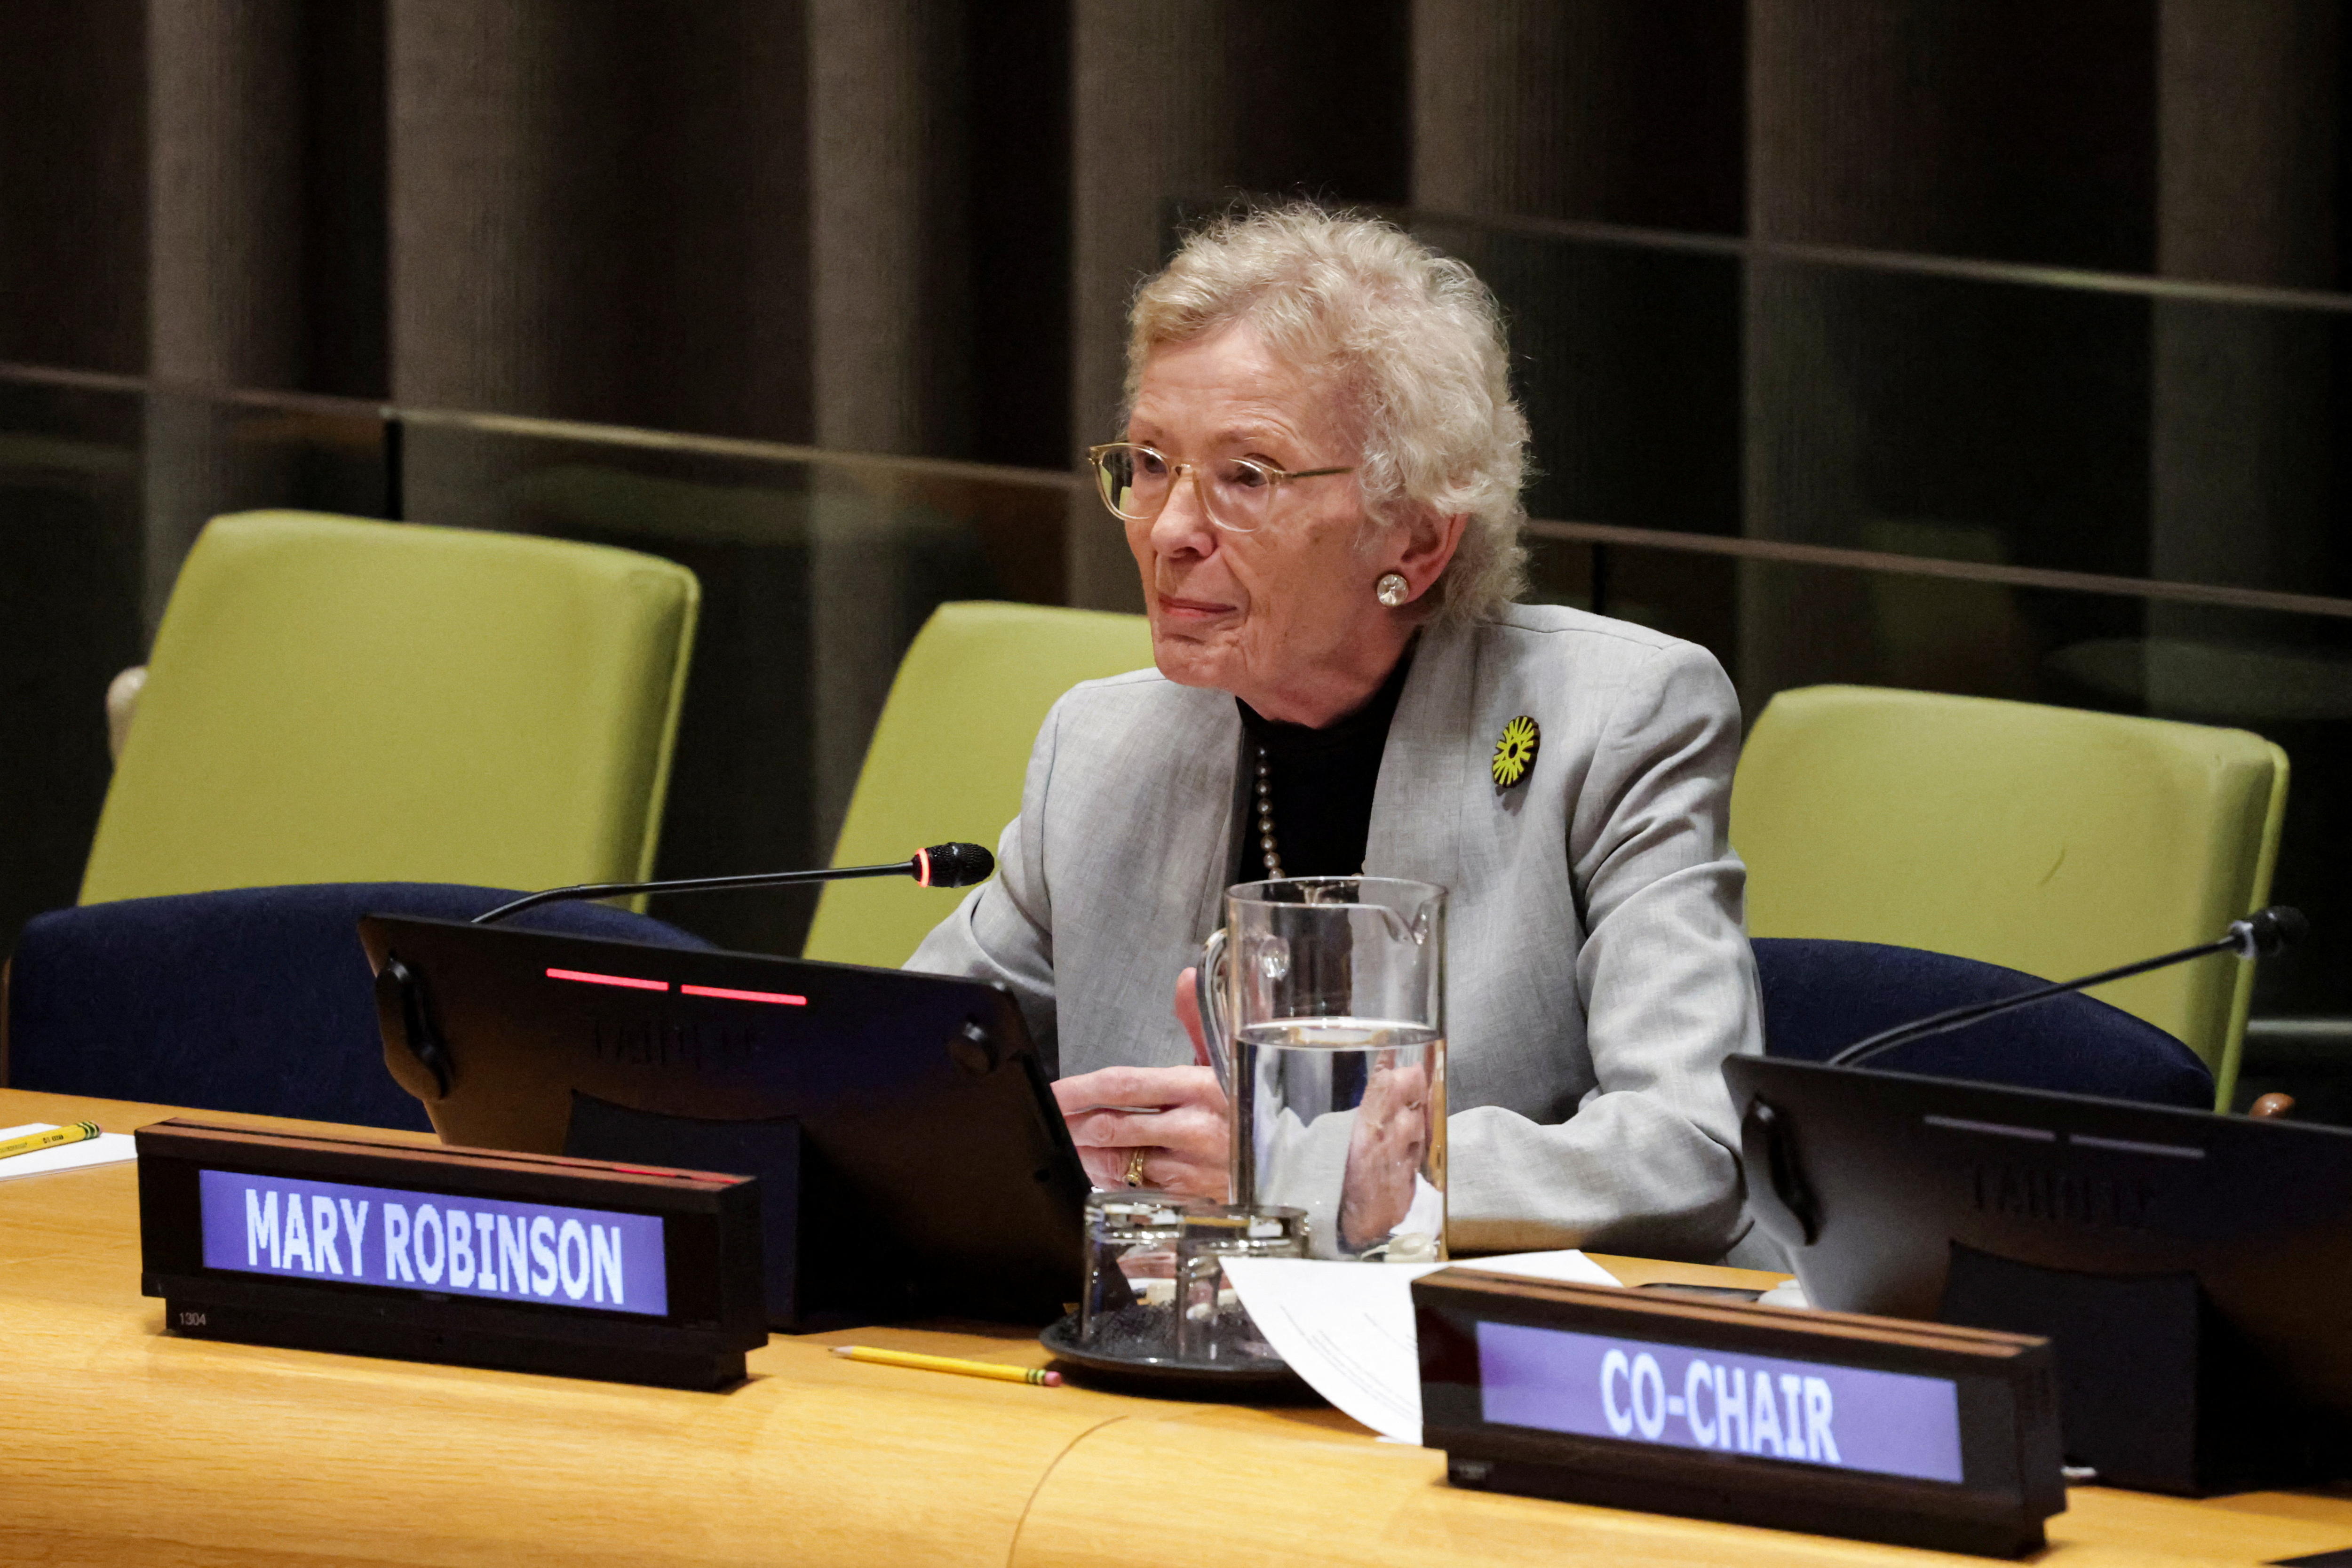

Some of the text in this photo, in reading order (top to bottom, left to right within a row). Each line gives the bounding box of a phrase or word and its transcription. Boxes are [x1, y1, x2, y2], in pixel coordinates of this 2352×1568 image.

[246, 1189, 624, 1305] MARY ROBINSON
[179, 1312, 206, 1326] 1304
[1601, 1349, 1840, 1463] CO-CHAIR
